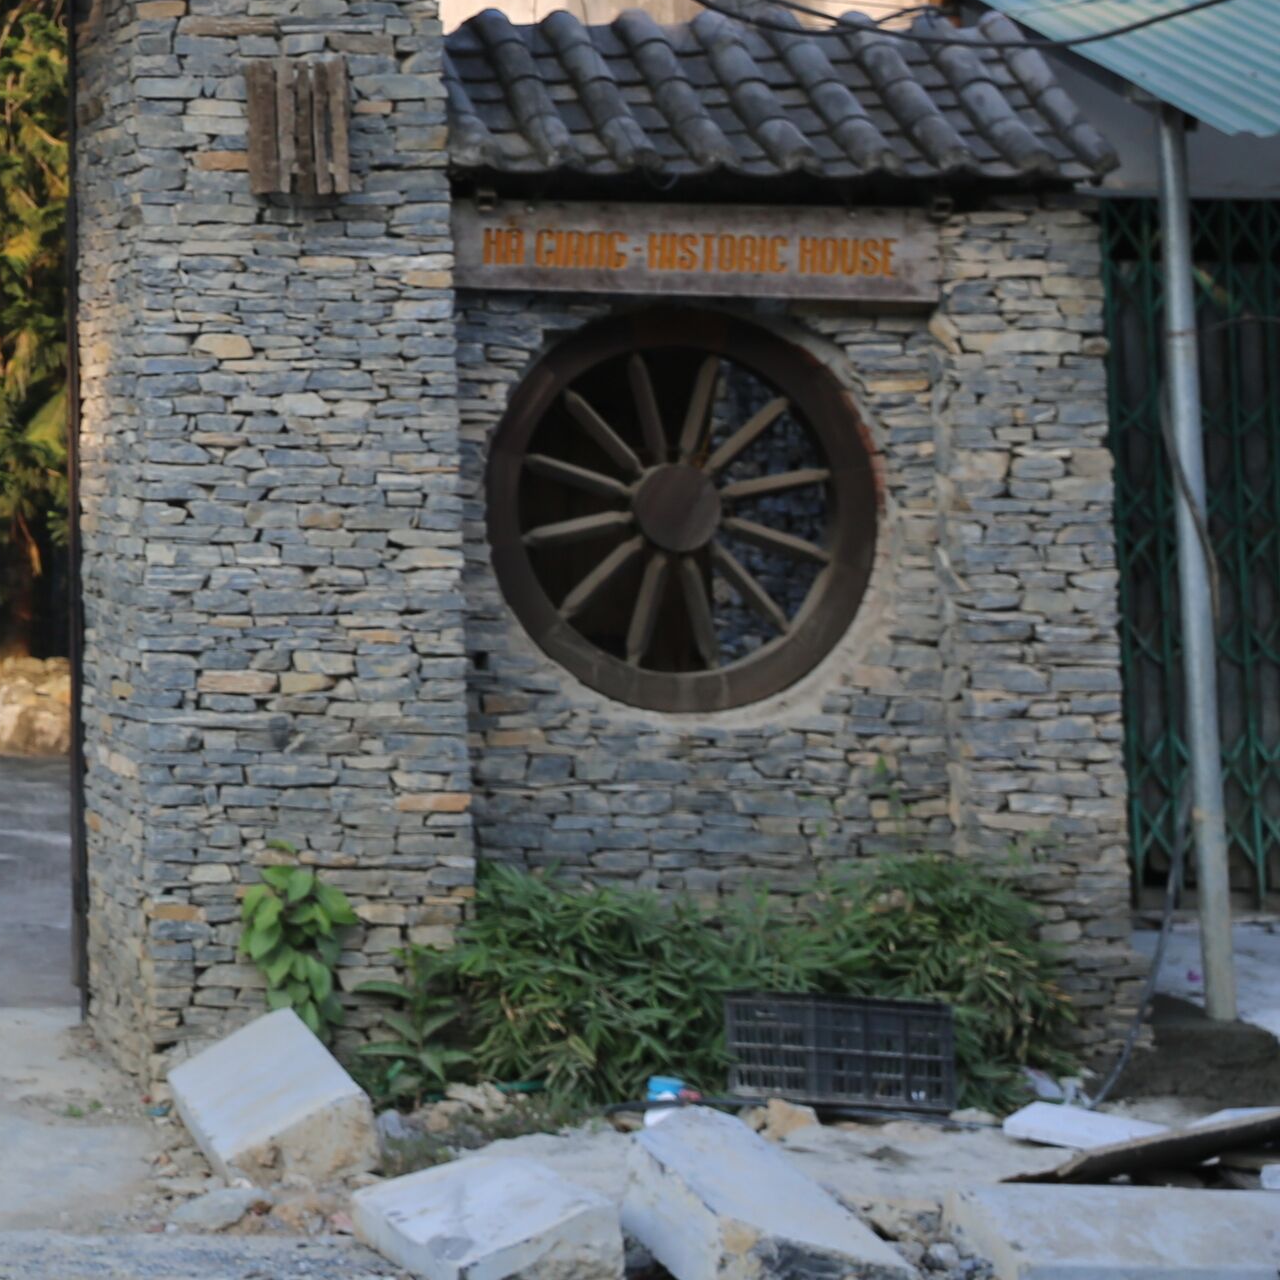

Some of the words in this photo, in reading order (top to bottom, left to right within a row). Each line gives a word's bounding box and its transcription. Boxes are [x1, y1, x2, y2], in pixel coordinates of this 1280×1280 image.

[535, 228, 629, 270] GIANG
[647, 231, 789, 274] HISTORIC
[798, 235, 900, 278] HOUSE
